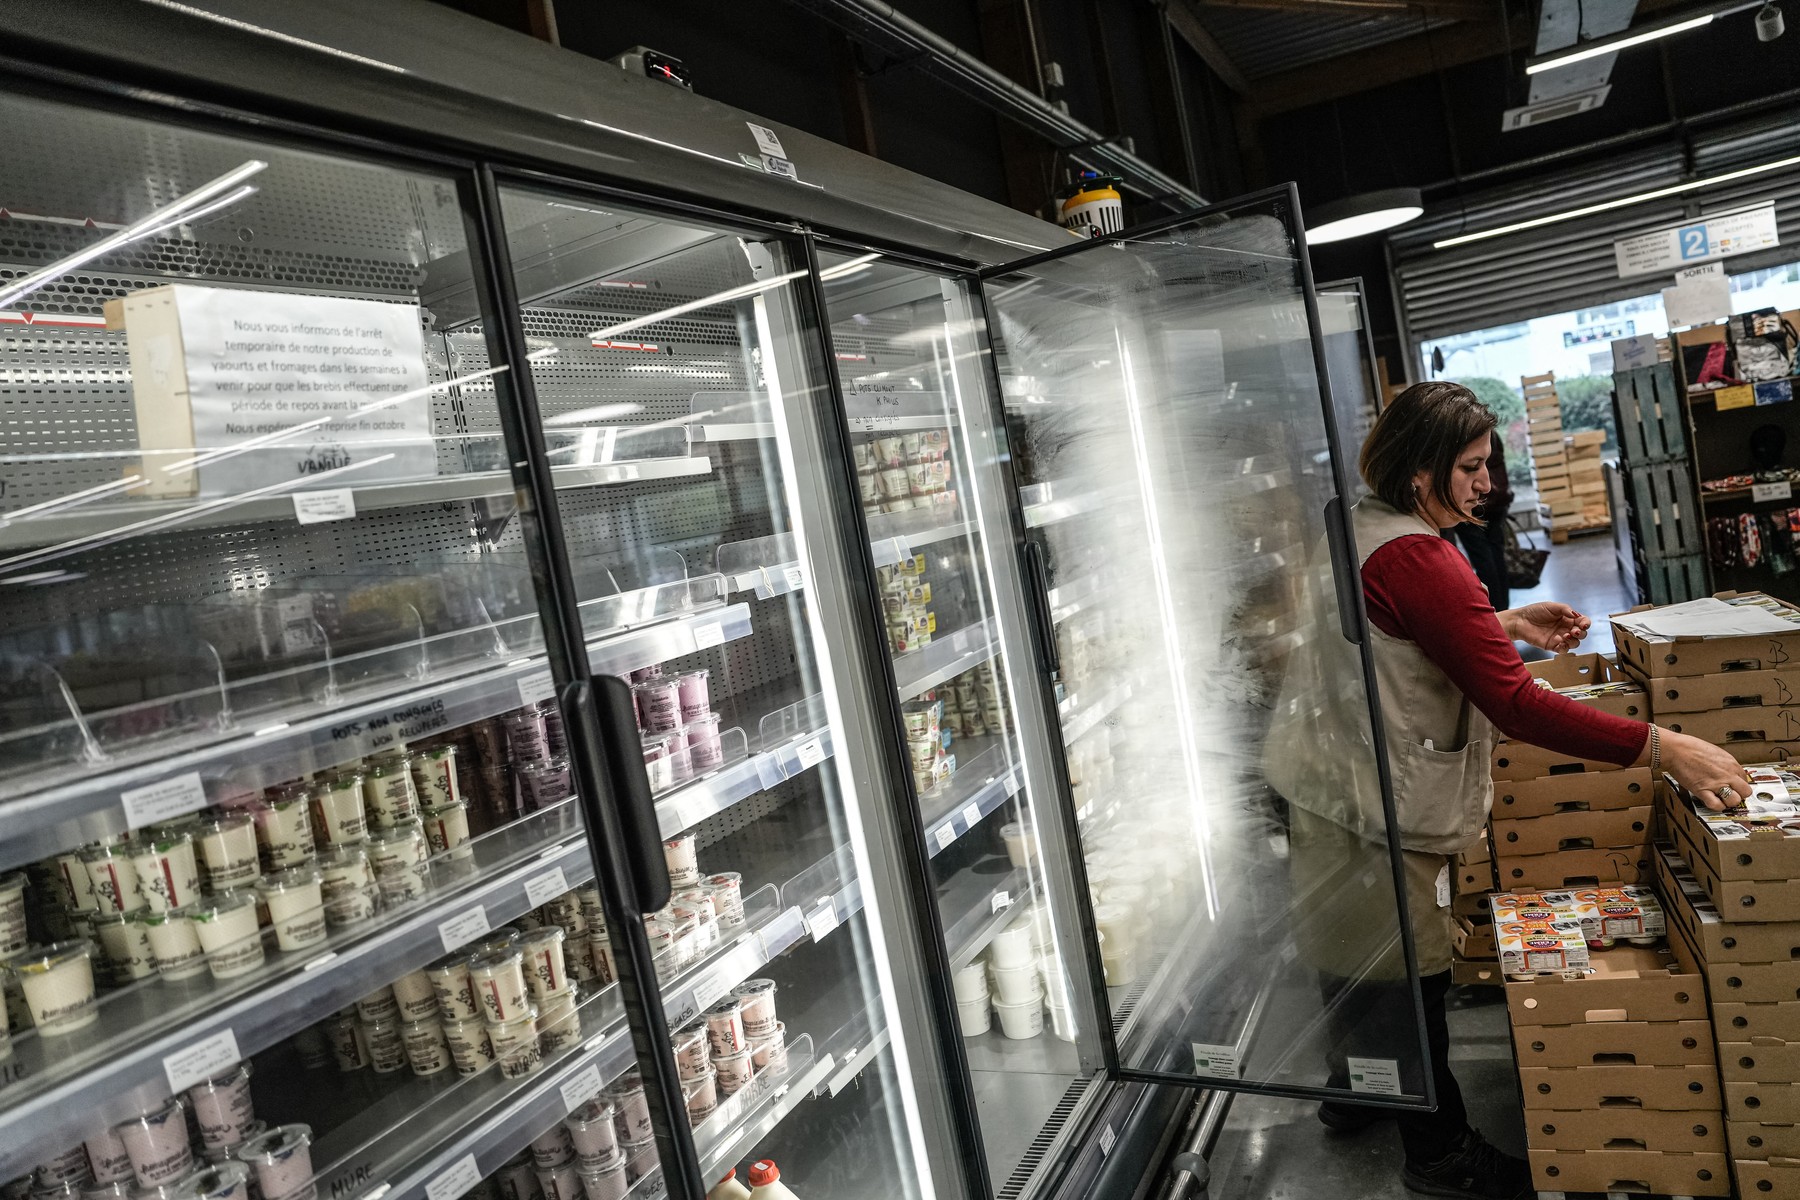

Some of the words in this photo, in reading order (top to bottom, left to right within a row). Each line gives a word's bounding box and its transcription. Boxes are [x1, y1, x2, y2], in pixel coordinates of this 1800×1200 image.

[1685, 230, 1705, 257] 2
[1683, 265, 1715, 279] SORTIE
[233, 320, 263, 332] Nous
[266, 324, 289, 333] vous
[291, 324, 341, 337] informons
[343, 327, 354, 337] de
[356, 326, 383, 339] l'arrêt
[225, 340, 286, 354] temporaire
[288, 342, 300, 352] de
[303, 344, 329, 354] notre
[332, 344, 381, 357] production
[383, 347, 393, 357] de
[211, 360, 254, 373] yaourts
[257, 361, 268, 372] et
[271, 360, 318, 374] fromages
[320, 363, 342, 373] dans
[344, 362, 357, 373] les
[359, 365, 400, 375] semaines
[401, 364, 408, 375] à
[216, 381, 244, 391] venir
[247, 383, 272, 394] pour
[275, 383, 294, 394] que
[297, 381, 311, 391] les
[313, 382, 342, 392] brebis
[343, 382, 390, 392] effectuent
[392, 384, 408, 392] une
[231, 400, 277, 412] période
[278, 401, 290, 410] de
[292, 402, 320, 412] repos
[322, 401, 346, 410] avant
[347, 400, 358, 410] la
[226, 423, 254, 434] Nous
[256, 424, 305, 435] espéro
[325, 421, 357, 432] reprise
[359, 420, 371, 431] fin
[372, 421, 405, 431] octobre
[331, 722, 362, 741] POTS
[368, 715, 389, 731] NON
[372, 734, 394, 748] NON
